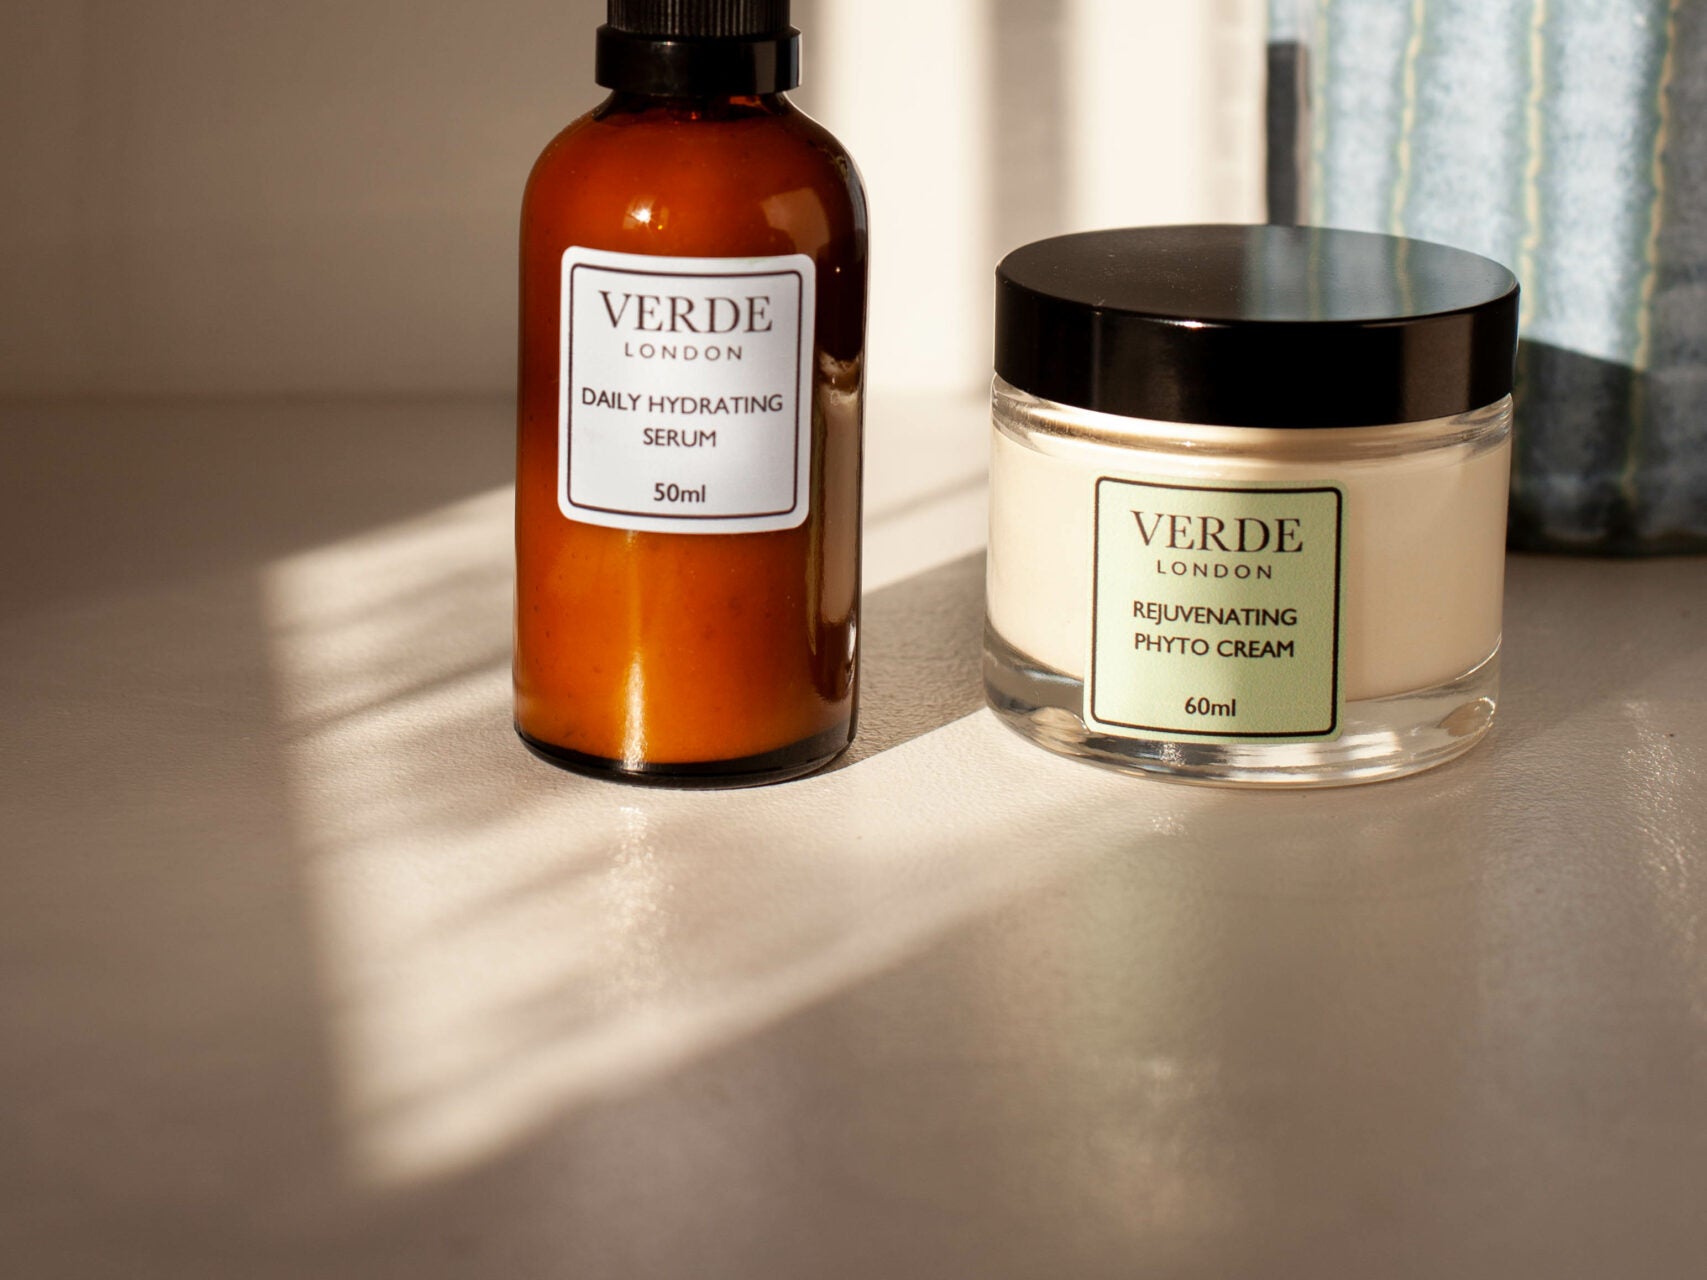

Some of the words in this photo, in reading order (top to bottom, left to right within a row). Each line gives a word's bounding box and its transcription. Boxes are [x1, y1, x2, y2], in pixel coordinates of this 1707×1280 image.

[597, 290, 774, 334] VERDE
[624, 342, 743, 361] LONDON
[581, 387, 641, 412] DAILY
[649, 394, 783, 415] HYDRATING
[643, 428, 717, 448] SERUM
[653, 483, 706, 503] 50ml
[1130, 510, 1304, 553] VERDE
[1157, 559, 1272, 580] LONDON
[1133, 600, 1298, 626] REJUVENATING
[1134, 632, 1209, 656] PHYTO
[1217, 640, 1295, 658] CREAM
[1184, 697, 1237, 717] 60ml
